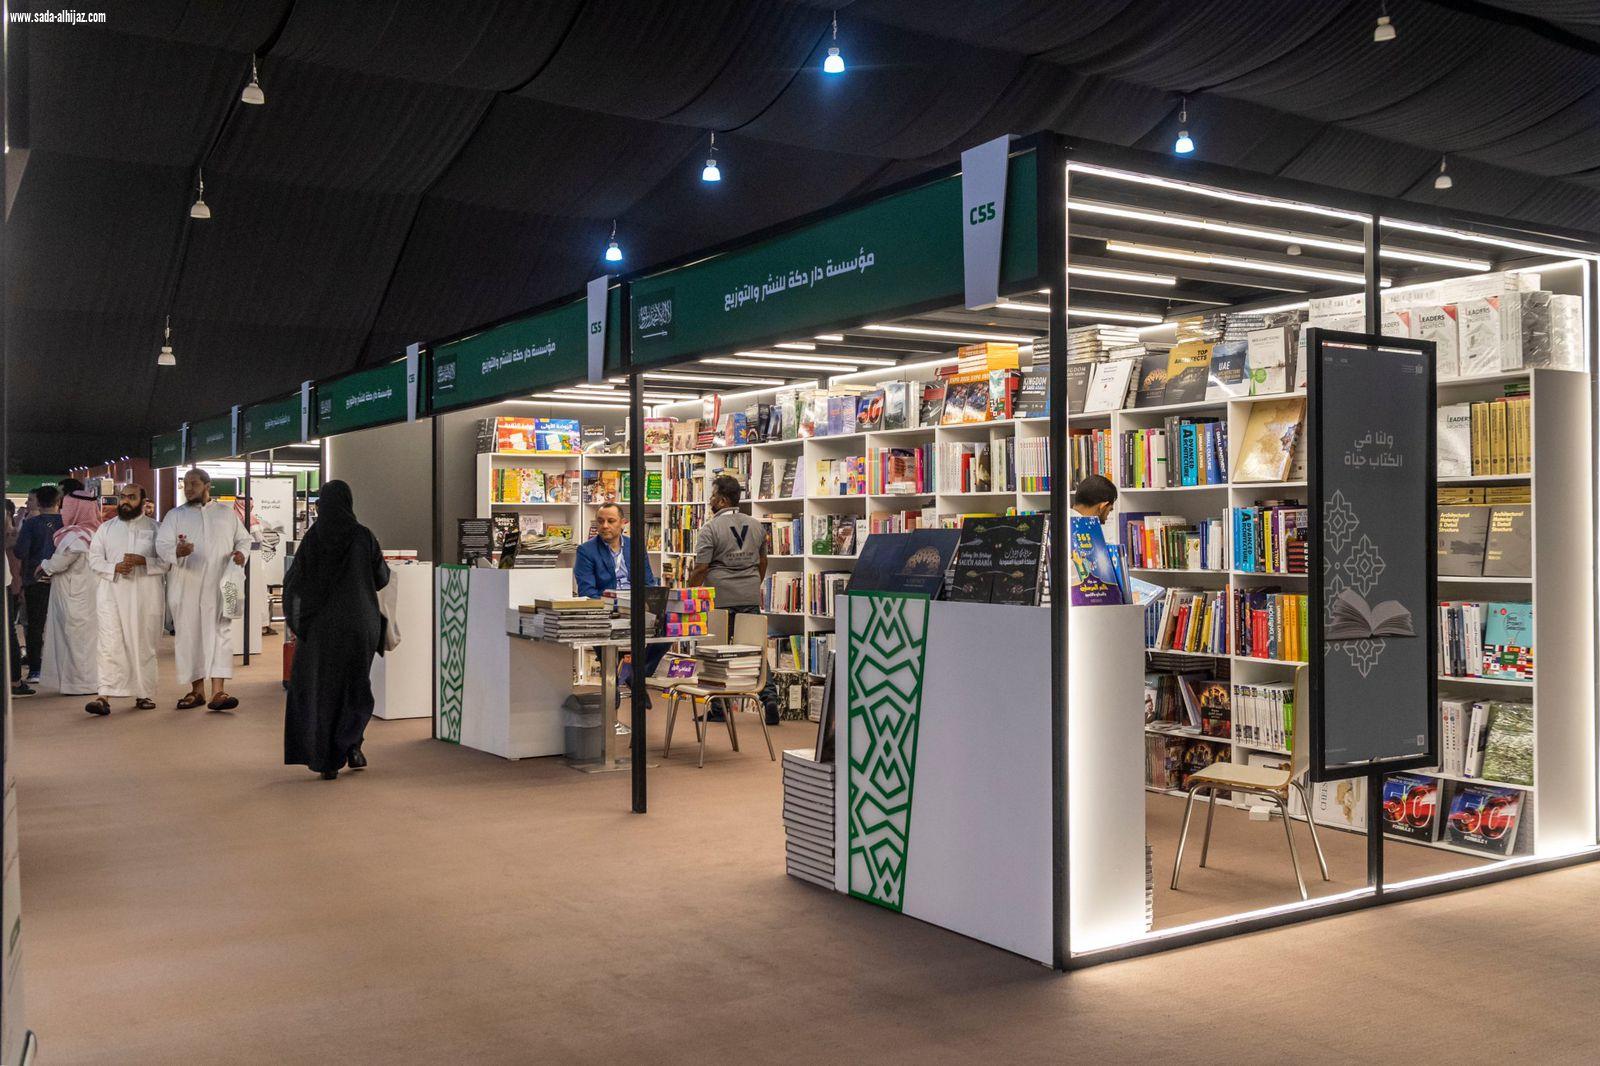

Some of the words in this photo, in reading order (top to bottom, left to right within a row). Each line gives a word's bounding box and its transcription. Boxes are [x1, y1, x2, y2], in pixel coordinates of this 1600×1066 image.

[826, 247, 875, 277] مؤسسة
[788, 269, 808, 288] دكة
[810, 265, 823, 288] دار
[762, 273, 786, 301] للنشر
[724, 284, 759, 312] والتوزيع
[1418, 314, 1445, 323] LEADERS
[1218, 361, 1231, 371] UAE
[1354, 429, 1373, 452] في
[1376, 430, 1394, 449] ولنا
[1344, 450, 1367, 469] حياة
[1369, 452, 1403, 470] الكتاب
[730, 525, 749, 550] V
[1077, 533, 1091, 541] 365
